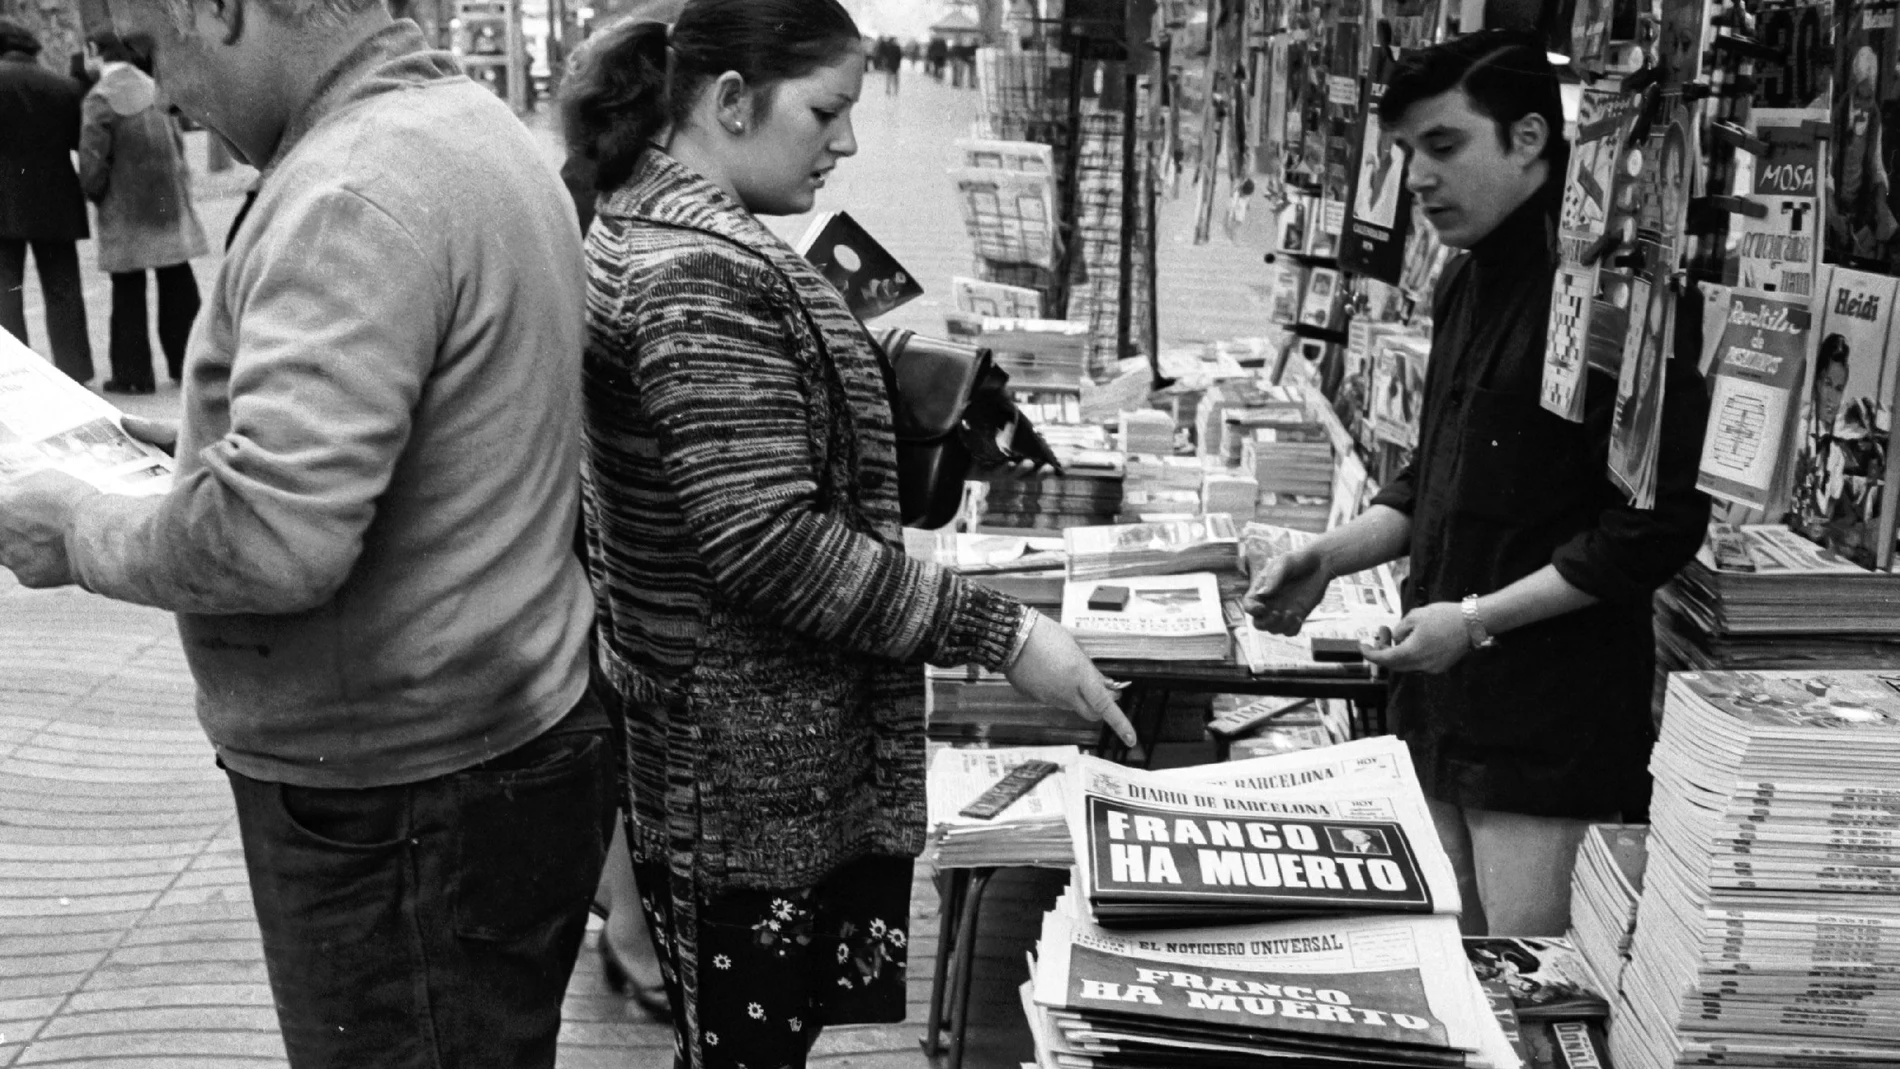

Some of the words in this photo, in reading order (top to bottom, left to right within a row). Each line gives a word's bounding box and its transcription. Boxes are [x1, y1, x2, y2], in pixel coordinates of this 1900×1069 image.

[1758, 163, 1814, 191] MOSA
[1834, 287, 1880, 322] Heidi
[1235, 767, 1334, 790] BARCELONA
[1128, 783, 1188, 805] DIARIO
[1194, 794, 1217, 809] DE
[1223, 797, 1330, 815] BARCELONA
[1107, 810, 1319, 851] FRANCO
[1110, 843, 1182, 884] HA
[1197, 848, 1407, 891] MUERTO
[1139, 941, 1161, 951] EL
[1166, 942, 1246, 956] NOTICIERO
[1250, 934, 1344, 955] UNIVERSAL
[1136, 967, 1351, 1005] FRANCO
[1080, 979, 1163, 1005] HA
[1185, 990, 1430, 1030] MUERTO
[1556, 1023, 1600, 1069] DONAL
